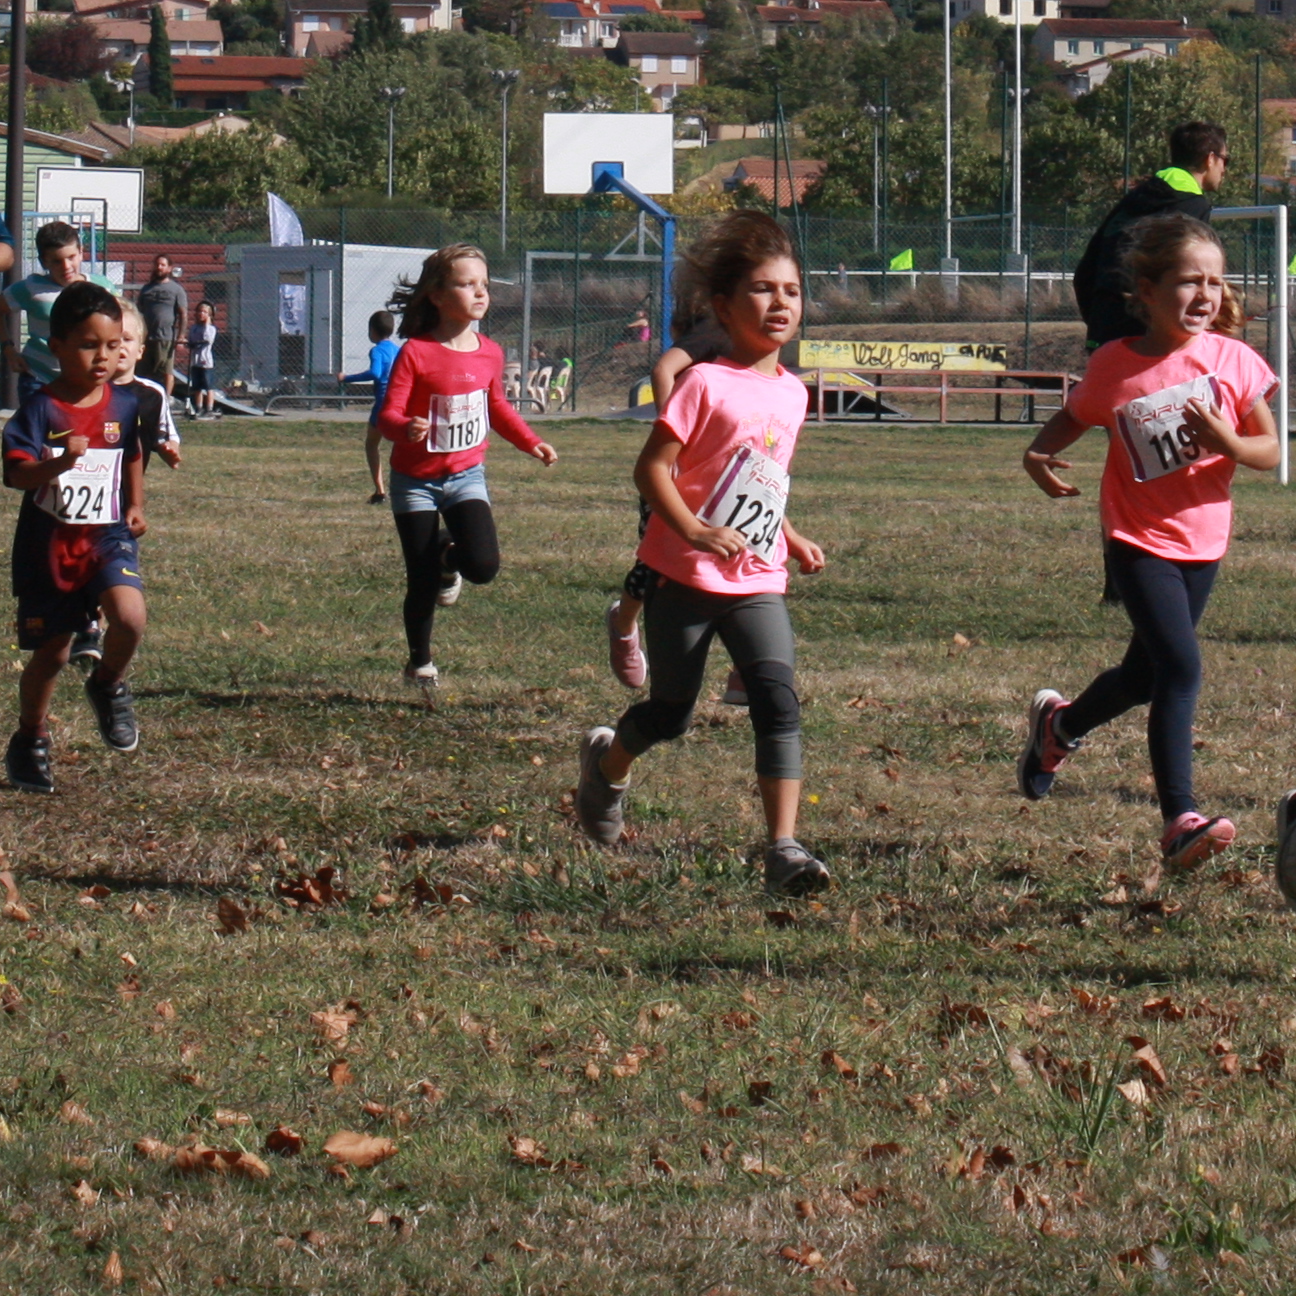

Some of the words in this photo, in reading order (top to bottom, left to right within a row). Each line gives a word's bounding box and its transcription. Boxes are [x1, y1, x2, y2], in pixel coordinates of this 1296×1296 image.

[448, 417, 480, 448] 1187
[1149, 424, 1200, 470] 119
[51, 486, 105, 519] 1224
[724, 494, 781, 554] 1234
